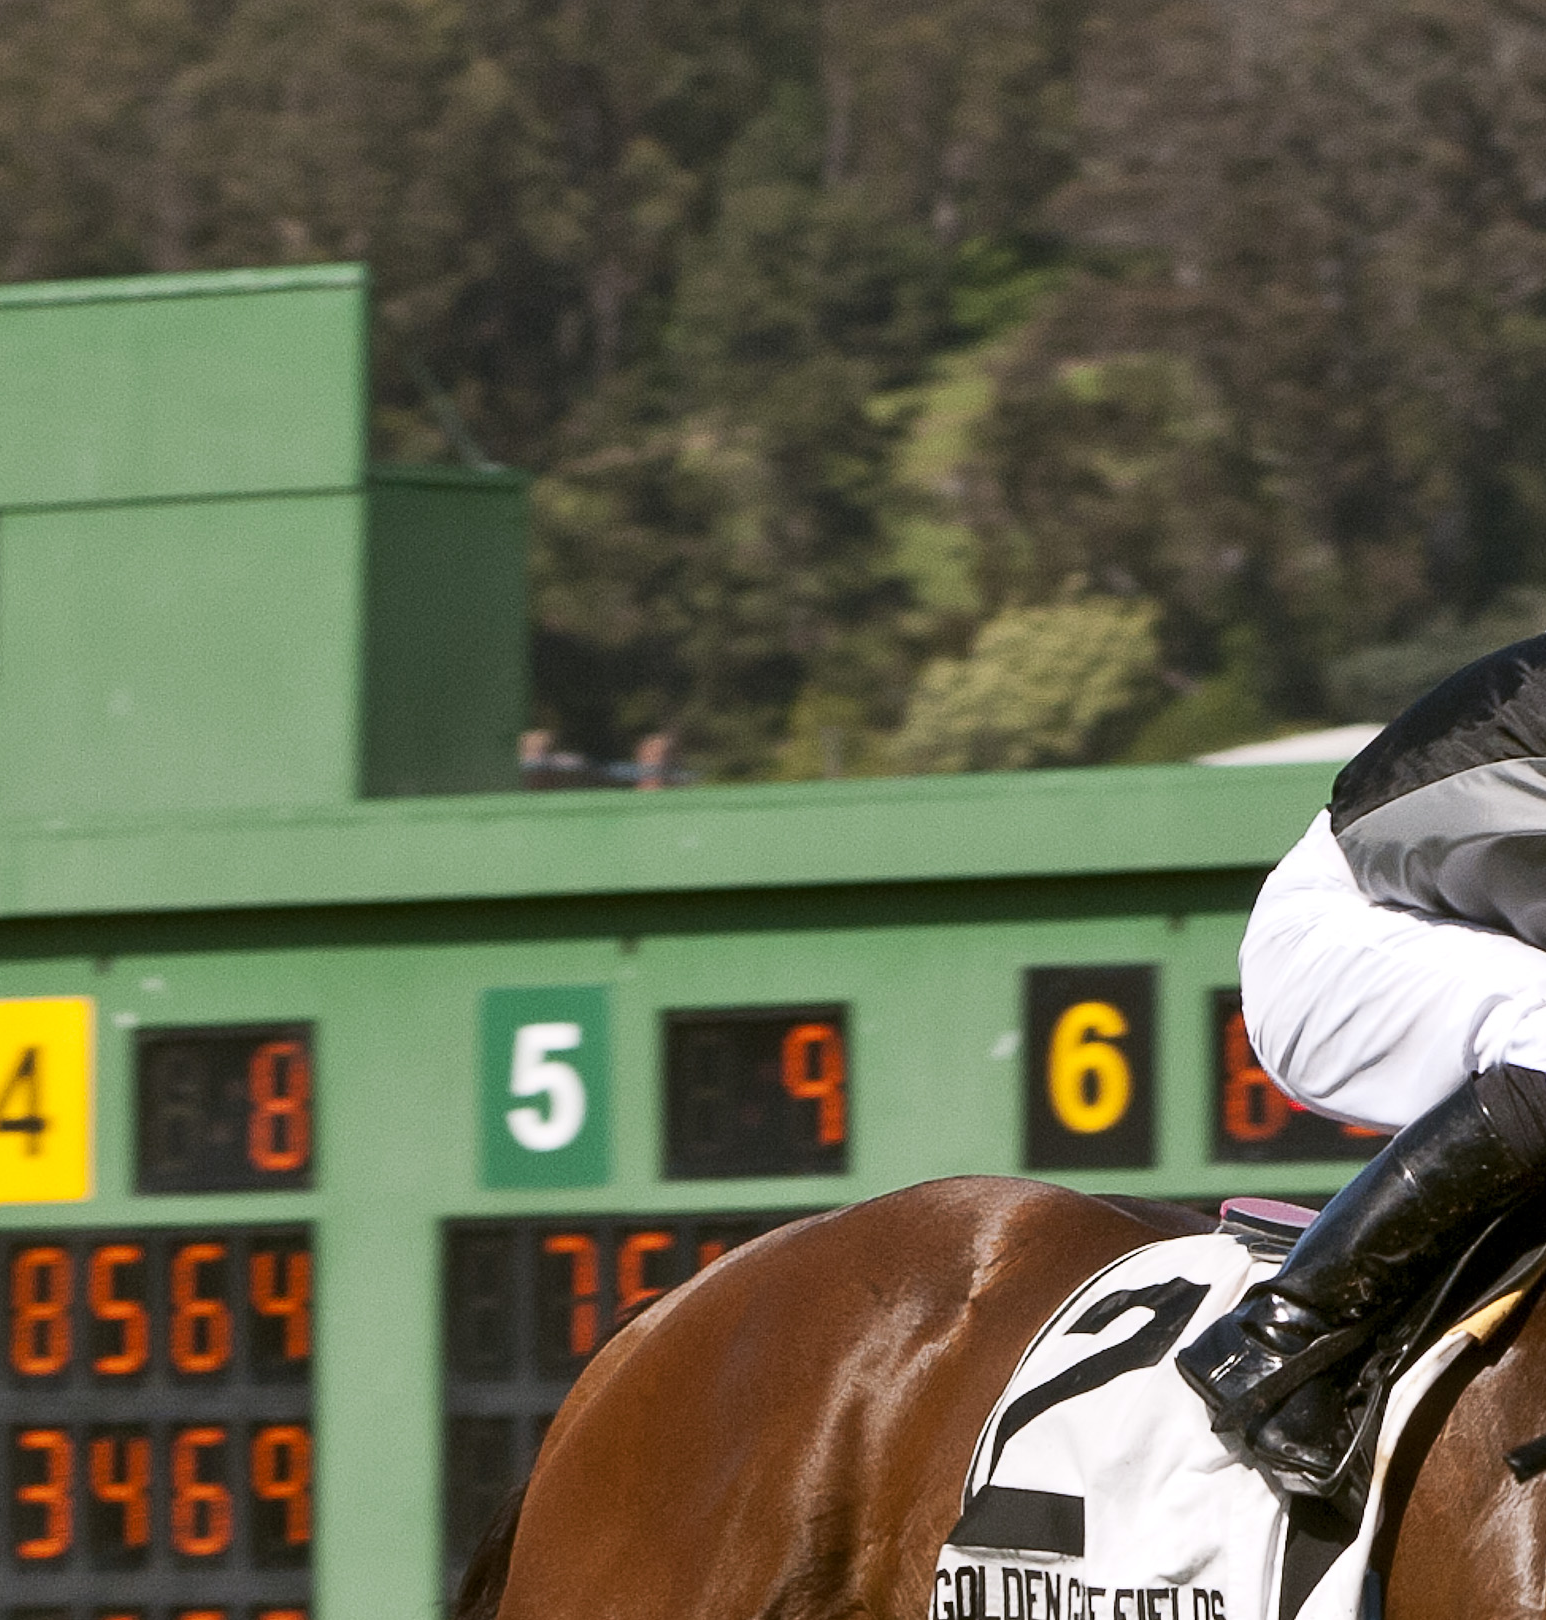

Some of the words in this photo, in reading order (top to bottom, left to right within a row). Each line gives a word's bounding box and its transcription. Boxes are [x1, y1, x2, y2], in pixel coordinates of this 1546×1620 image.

[248, 1040, 312, 1173] 8
[506, 1022, 586, 1151] 5
[780, 1020, 846, 1147] 9
[1048, 1001, 1131, 1134] 6
[9, 1242, 313, 1377] 8564
[942, 1276, 1212, 1559] 2
[14, 1424, 313, 1562] 3469
